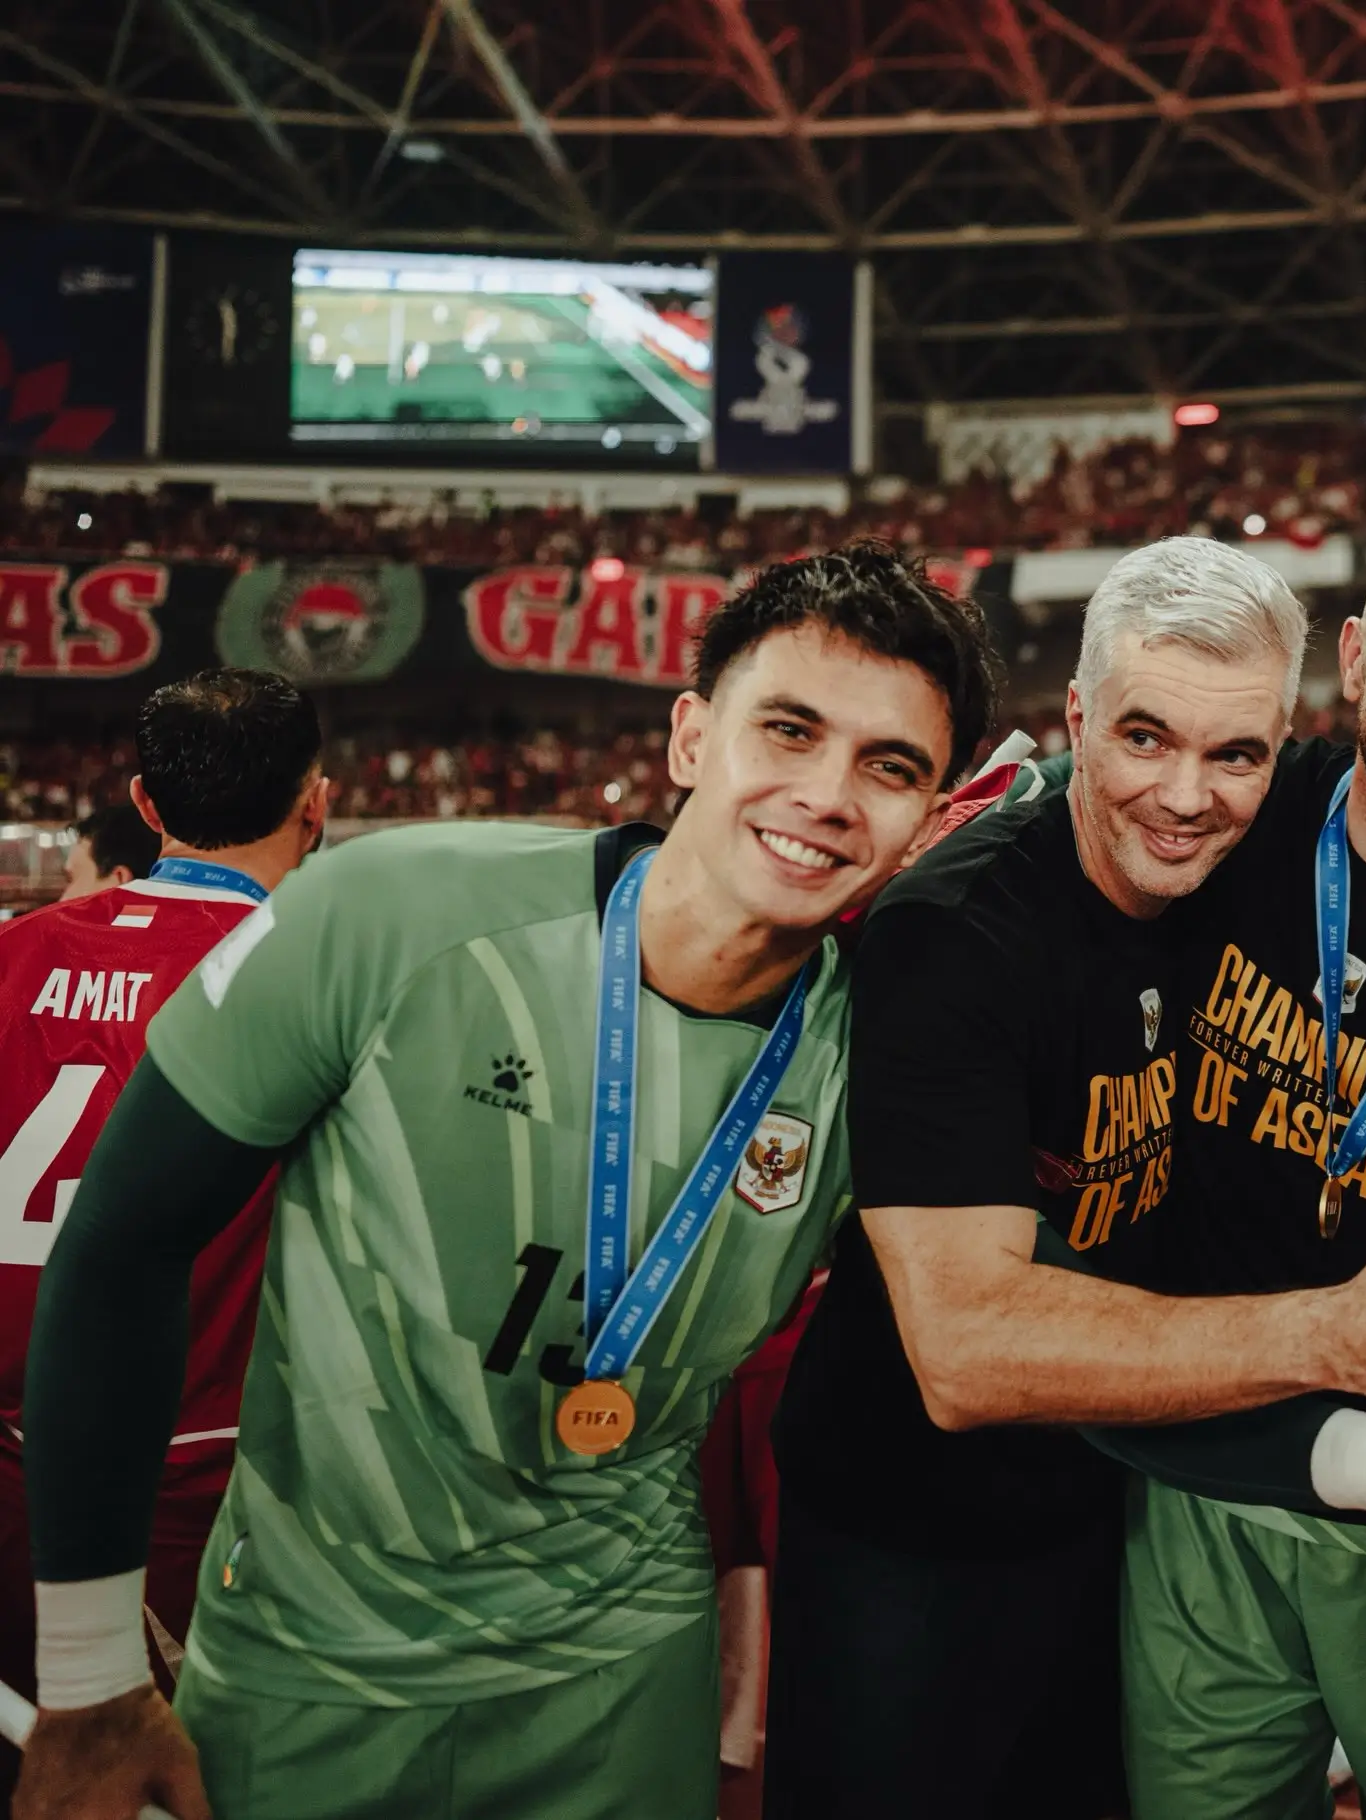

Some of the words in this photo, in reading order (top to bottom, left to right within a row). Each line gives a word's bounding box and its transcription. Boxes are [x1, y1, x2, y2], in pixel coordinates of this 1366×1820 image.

[1329, 843, 1339, 868] FIFA
[1329, 883, 1339, 909] FIFA
[615, 926, 627, 960] FIFA
[1328, 925, 1338, 951] FIFA
[30, 968, 153, 1022] AMAT
[611, 978, 624, 1011] FIFA
[610, 1029, 623, 1063] FIFA
[774, 1032, 792, 1063] FIFA
[1190, 1018, 1248, 1067] FOREVER
[463, 1084, 534, 1117] KELME
[608, 1081, 621, 1115] FIFA
[750, 1075, 770, 1107] FIFA
[1193, 1050, 1249, 1127] OF
[1083, 1051, 1176, 1163] CHAMP
[606, 1132, 620, 1167] FIFA
[724, 1119, 746, 1151] FIFA
[0, 1064, 107, 1266] 4
[700, 1164, 722, 1198] FIFA
[603, 1184, 617, 1219] FIFA
[1068, 1171, 1134, 1253] OF
[673, 1210, 697, 1244] FIFA
[601, 1236, 614, 1269] FIFA
[645, 1257, 671, 1291] FIFA
[617, 1304, 643, 1340] FIFA
[572, 1410, 619, 1427] FIFA
